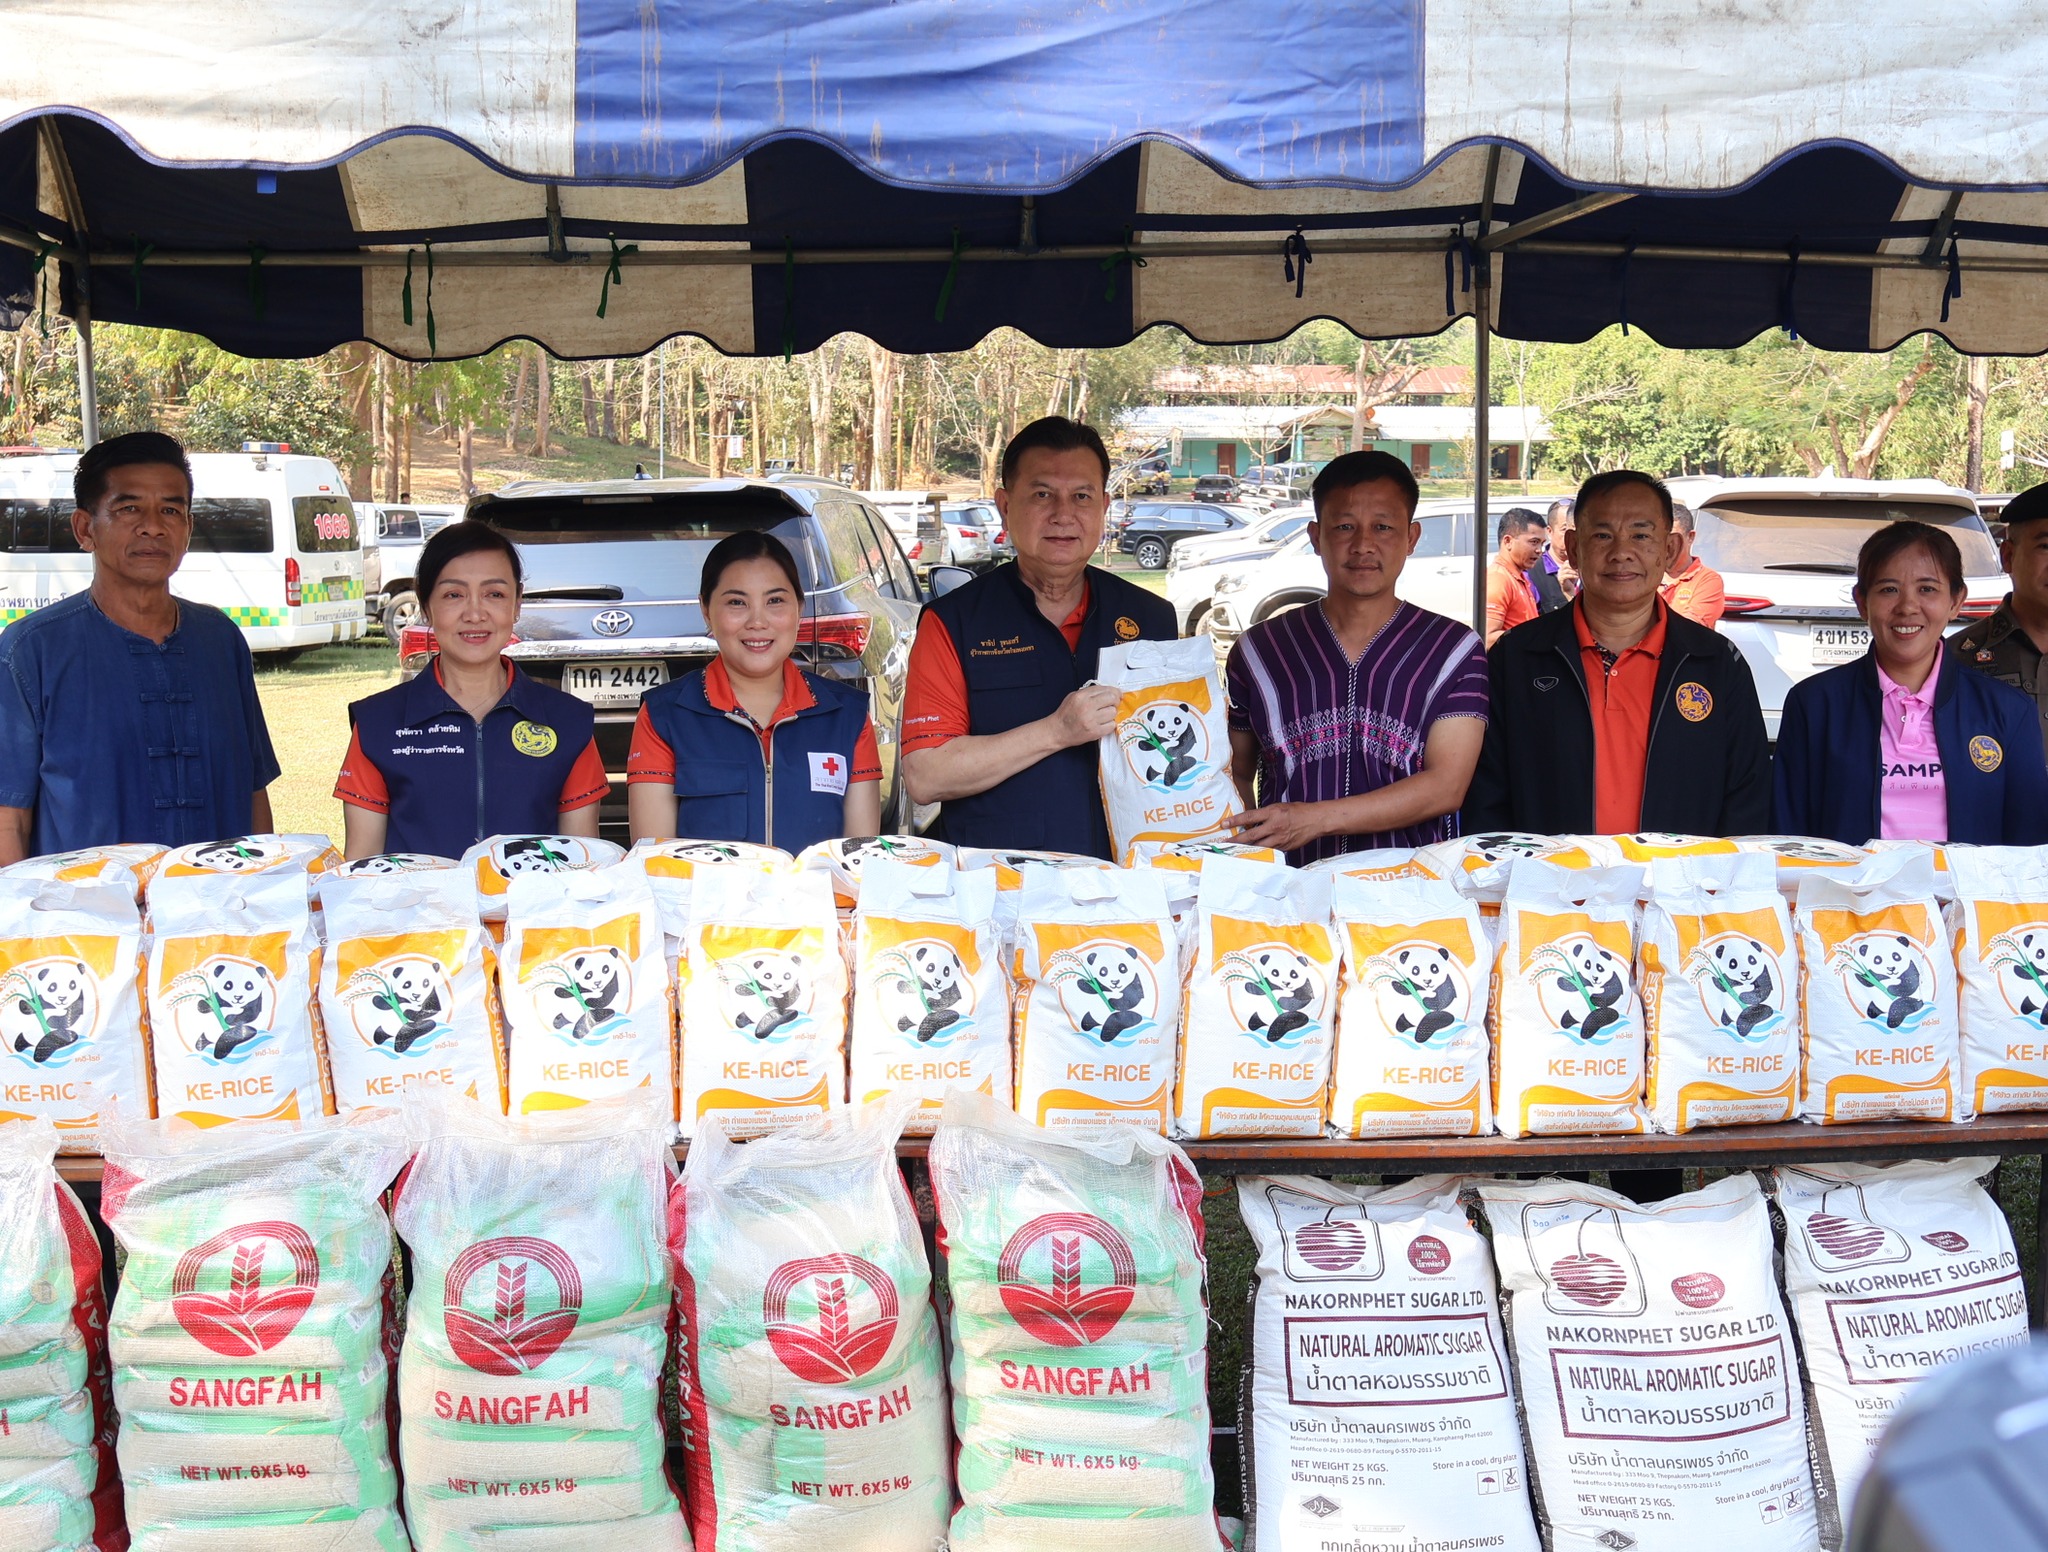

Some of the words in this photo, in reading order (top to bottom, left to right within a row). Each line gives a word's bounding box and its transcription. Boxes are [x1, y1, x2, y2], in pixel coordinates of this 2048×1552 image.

[314, 513, 350, 540] 1669
[611, 666, 660, 688] 2442
[1143, 795, 1215, 825] KE-RICE
[1707, 1054, 1783, 1074] KE-RICE
[1855, 1045, 1934, 1066] KE-RICE
[542, 1059, 629, 1082] KE-RICE
[723, 1060, 809, 1079] KE-RICE
[886, 1060, 971, 1080] KE-RICE
[1066, 1063, 1151, 1082] KE-RICE
[1232, 1061, 1314, 1081] KE-RICE
[1383, 1065, 1465, 1084] KE-RICE
[1547, 1058, 1627, 1077] KE-RICE
[5, 1082, 92, 1102] KE-RIC
[186, 1076, 274, 1101] KE-RICE
[1415, 1241, 1442, 1249] NATURAL
[1421, 1250, 1437, 1259] 100%
[1819, 1268, 1943, 1294] NAKORNPHET
[1947, 1257, 1997, 1281] SUGAR
[1998, 1253, 2018, 1270] LTD.
[1285, 1293, 1405, 1310] NAKORNPHET
[1411, 1291, 1460, 1308] SUGAR
[1462, 1290, 1486, 1306] LTD.
[1846, 1313, 1924, 1339] NATURAL
[1926, 1303, 1997, 1334] AROMATIC
[1998, 1290, 2027, 1321] SUGAR
[1546, 1326, 1673, 1345] NAKORNPHET
[1680, 1321, 1742, 1342] SUGAR
[1747, 1313, 1778, 1334] LTD.
[1300, 1334, 1370, 1358] NATURAL
[1374, 1332, 1444, 1357] AROMATIC
[1443, 1330, 1486, 1355] SUGAR
[1000, 1359, 1150, 1396] SANGFAH
[1306, 1364, 1491, 1391] น้ำตาลหอมธรรมชาติ
[1569, 1365, 1642, 1392] NATURAL
[1646, 1364, 1725, 1392] AROMATIC
[1727, 1355, 1777, 1386] SUGAR
[170, 1372, 321, 1408] SANGFAH
[434, 1386, 589, 1425] SANGFAH
[770, 1385, 912, 1430] SANGFAH
[1581, 1391, 1774, 1426] น้ำตาลหอมธรรมชาติ
[1855, 1397, 1895, 1411] บริษัท
[1290, 1418, 1326, 1434] บริษัท
[1331, 1415, 1435, 1434] น้ำตาลนครเพชร
[1439, 1417, 1471, 1432] จำกัด
[1015, 1447, 1045, 1465] NET
[1051, 1453, 1080, 1469] WT.
[1083, 1455, 1115, 1470] 6X5
[1119, 1454, 1141, 1471] kg.
[1291, 1459, 1310, 1470] NET
[1311, 1461, 1350, 1473] WEIGHT
[1352, 1463, 1365, 1472] 25
[1367, 1463, 1389, 1473] KGS.
[1432, 1461, 1455, 1471] Store
[1456, 1460, 1463, 1469] in
[1471, 1457, 1488, 1469] cool,
[1489, 1456, 1502, 1466] dry
[1502, 1453, 1518, 1464] place
[1568, 1451, 1608, 1467] บริษัท
[1611, 1450, 1714, 1469] น้ำตาลนครเพชร
[1717, 1448, 1749, 1467] จำกัด
[181, 1465, 210, 1480] NET
[216, 1466, 247, 1481] WT.
[250, 1464, 282, 1480] 6X5
[286, 1463, 310, 1479] kg.
[1291, 1471, 1349, 1488] ปริมาณสุทธิ
[1352, 1476, 1365, 1486] 25
[1368, 1477, 1386, 1487] กก.
[448, 1477, 478, 1495] NET
[485, 1482, 515, 1497] WT.
[519, 1480, 550, 1496] 6X5
[555, 1477, 578, 1492] kg.
[792, 1480, 822, 1496] NET
[828, 1483, 858, 1497] WT.
[861, 1480, 890, 1496] 6X5
[894, 1475, 912, 1491] kg.
[1715, 1495, 1736, 1506] Store
[1737, 1494, 1744, 1502] in
[1751, 1487, 1769, 1499] cool,
[1769, 1483, 1783, 1495] dry
[1783, 1475, 1801, 1490] place
[1578, 1494, 1597, 1503] NET
[1599, 1495, 1637, 1506] WEIGHT
[1640, 1497, 1651, 1506] 25
[1653, 1498, 1675, 1508] KGS.
[1580, 1506, 1640, 1522] ปริมาณสุทธิ
[1642, 1511, 1654, 1520] 25
[1657, 1511, 1675, 1521] กก.
[1321, 1537, 1405, 1552] ทกเกล็ดหวาน
[1408, 1534, 1504, 1552] น้ำตาลนครเพชร
